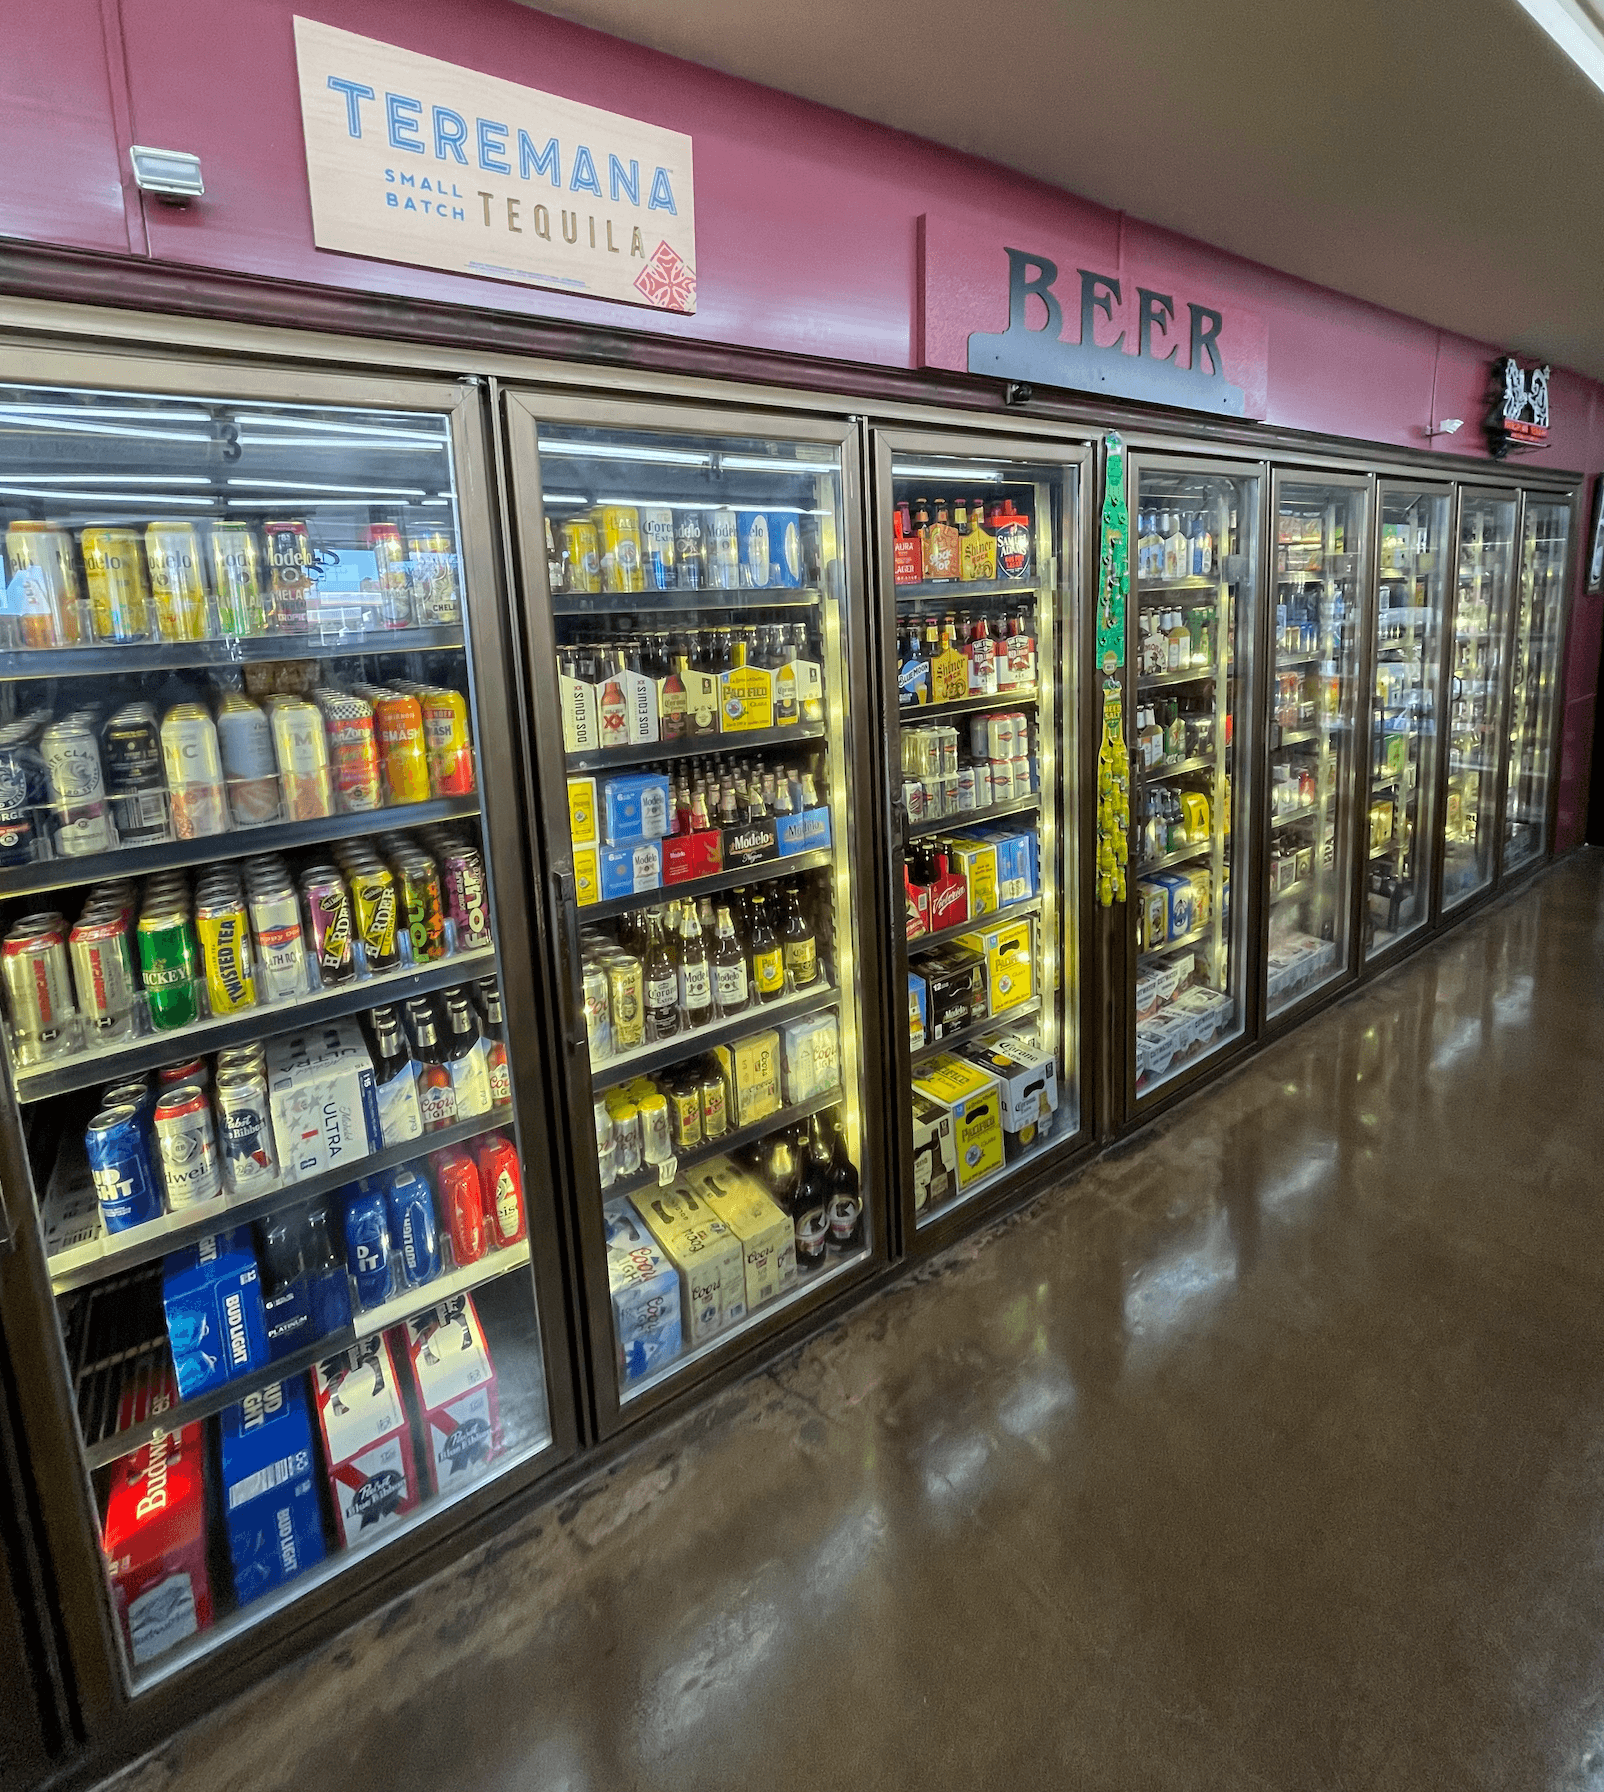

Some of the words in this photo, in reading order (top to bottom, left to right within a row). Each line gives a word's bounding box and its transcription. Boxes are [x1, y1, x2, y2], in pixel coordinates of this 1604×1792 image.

[327, 75, 677, 216] TEREMANA
[384, 168, 463, 198] SMALL
[386, 192, 465, 222] BATCH
[477, 191, 646, 258] TEQUILA
[1003, 246, 1224, 377] BEER
[913, 661, 930, 679] MOON
[573, 692, 586, 721] EQUIS
[637, 686, 648, 715] EQUIS
[577, 724, 587, 743] DOS
[639, 716, 649, 735] DOS
[734, 831, 769, 851] Modelo
[217, 919, 236, 946] TEA
[364, 887, 394, 959] HARDER
[218, 947, 247, 1004] TWISTED
[323, 1102, 342, 1158] ULTRA
[226, 1294, 241, 1327] BUD
[268, 1315, 308, 1338] PLATINUM
[230, 1323, 248, 1365] LIGHT
[277, 1508, 291, 1537] BUD
[280, 1535, 298, 1573] LIGHT
